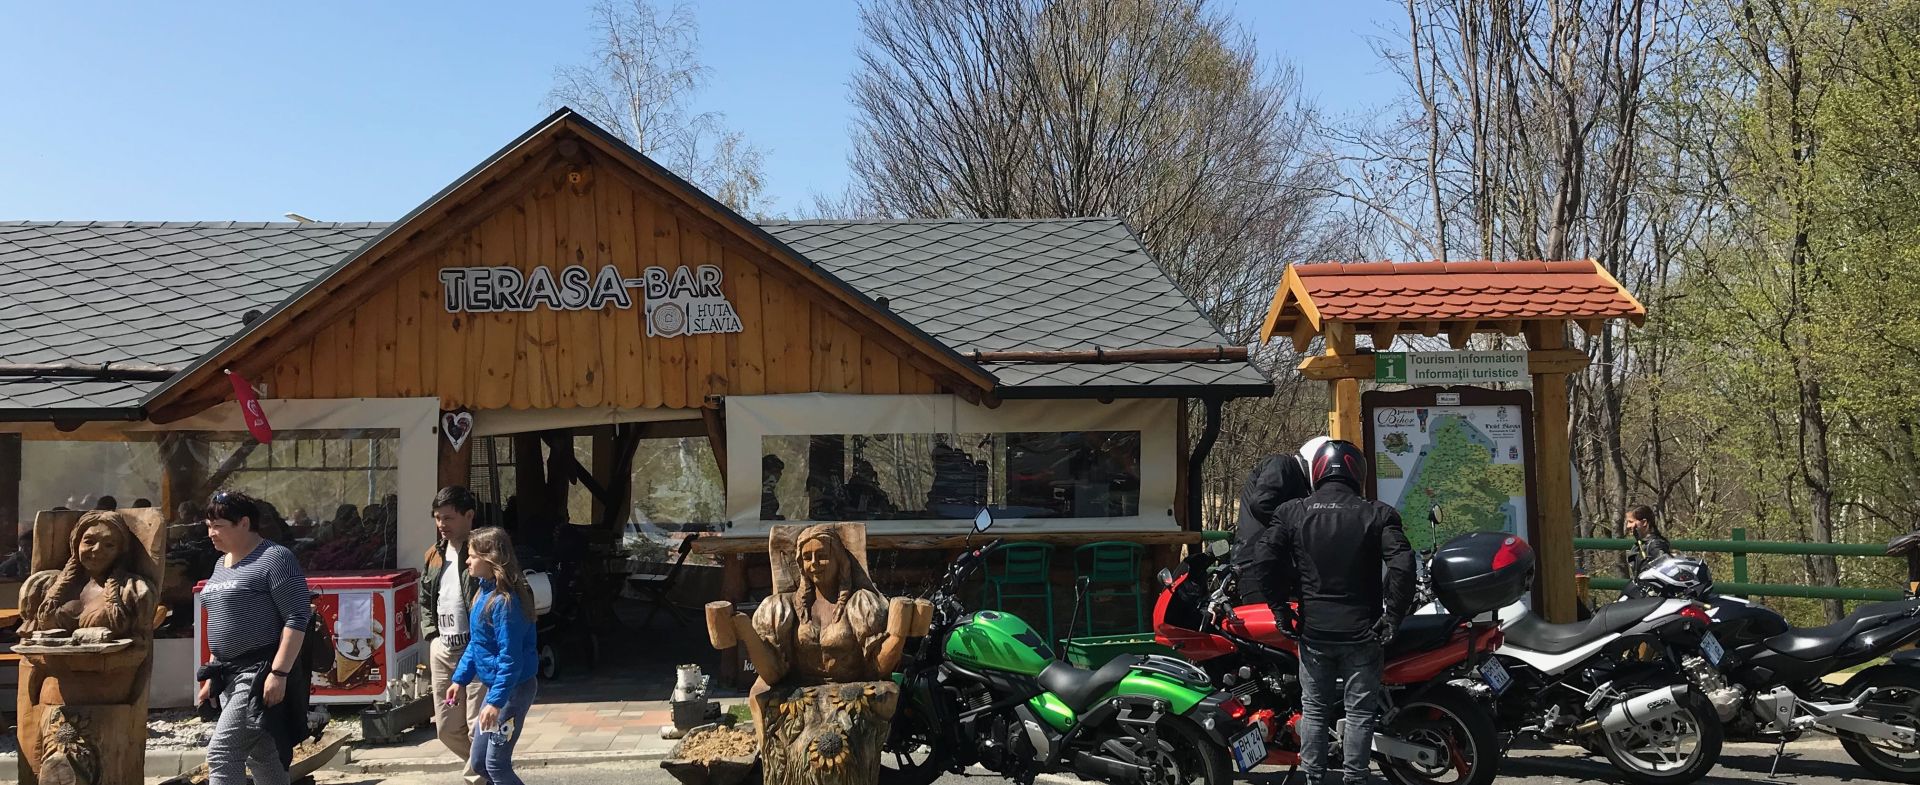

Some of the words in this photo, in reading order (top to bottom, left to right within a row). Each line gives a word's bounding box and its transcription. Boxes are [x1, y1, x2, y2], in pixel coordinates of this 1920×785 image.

[441, 265, 722, 312] TERASA-BAR
[697, 303, 732, 317] HUTA
[693, 317, 741, 332] SLAVIA
[1409, 354, 1455, 365] Tourism
[1459, 353, 1524, 364] Information
[1472, 368, 1519, 379] turistice
[1377, 407, 1415, 425] Bihor
[1239, 736, 1251, 753] BH
[1250, 731, 1261, 745] 24
[1247, 746, 1262, 763] WLJ
